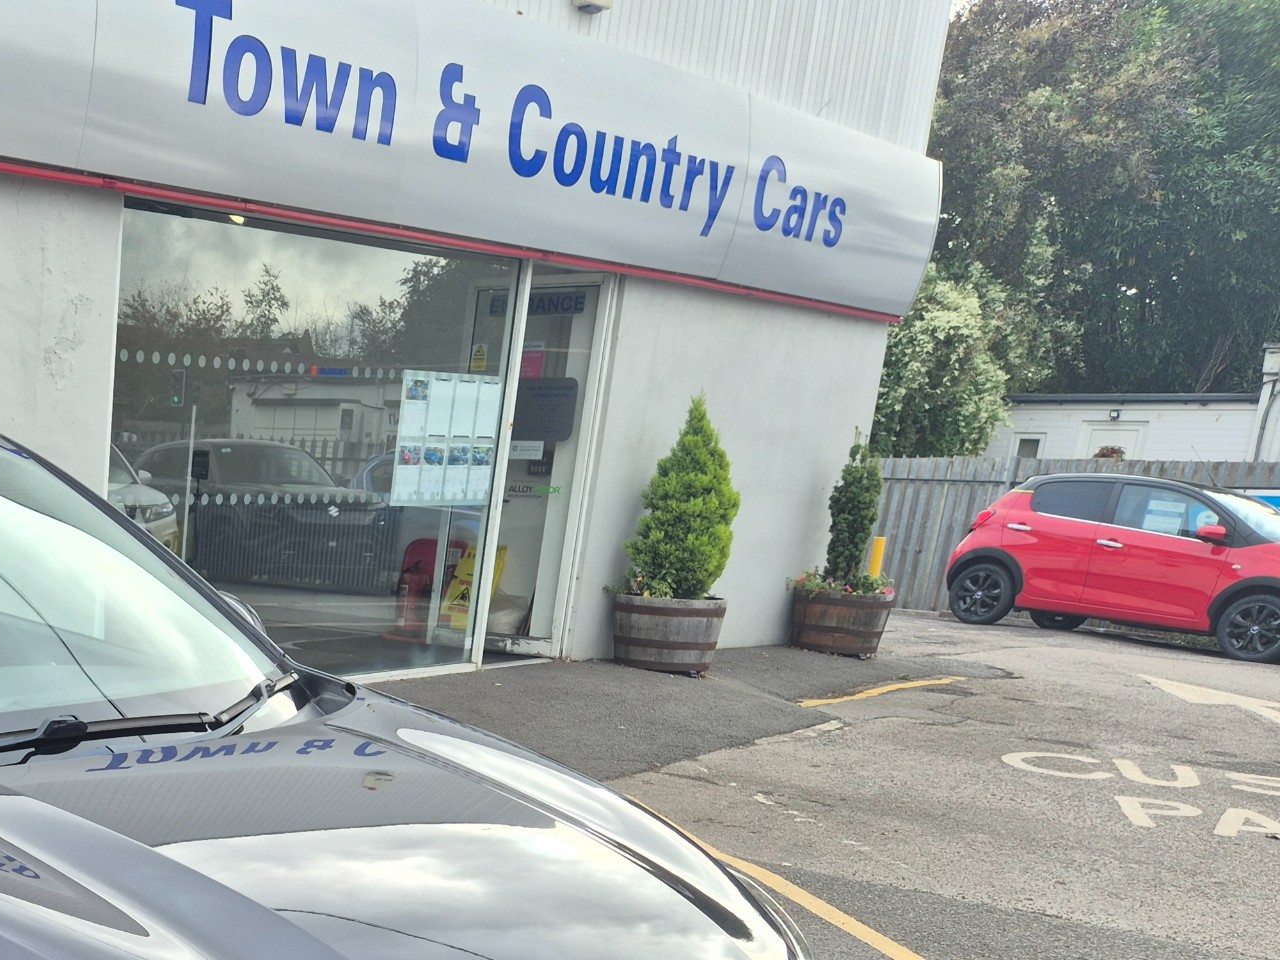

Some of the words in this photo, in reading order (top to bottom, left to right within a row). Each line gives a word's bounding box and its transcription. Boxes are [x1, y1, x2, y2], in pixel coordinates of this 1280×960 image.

[175, 0, 397, 146] Town
[433, 62, 480, 163] &
[508, 84, 735, 237] Country
[753, 155, 846, 248] Cars
